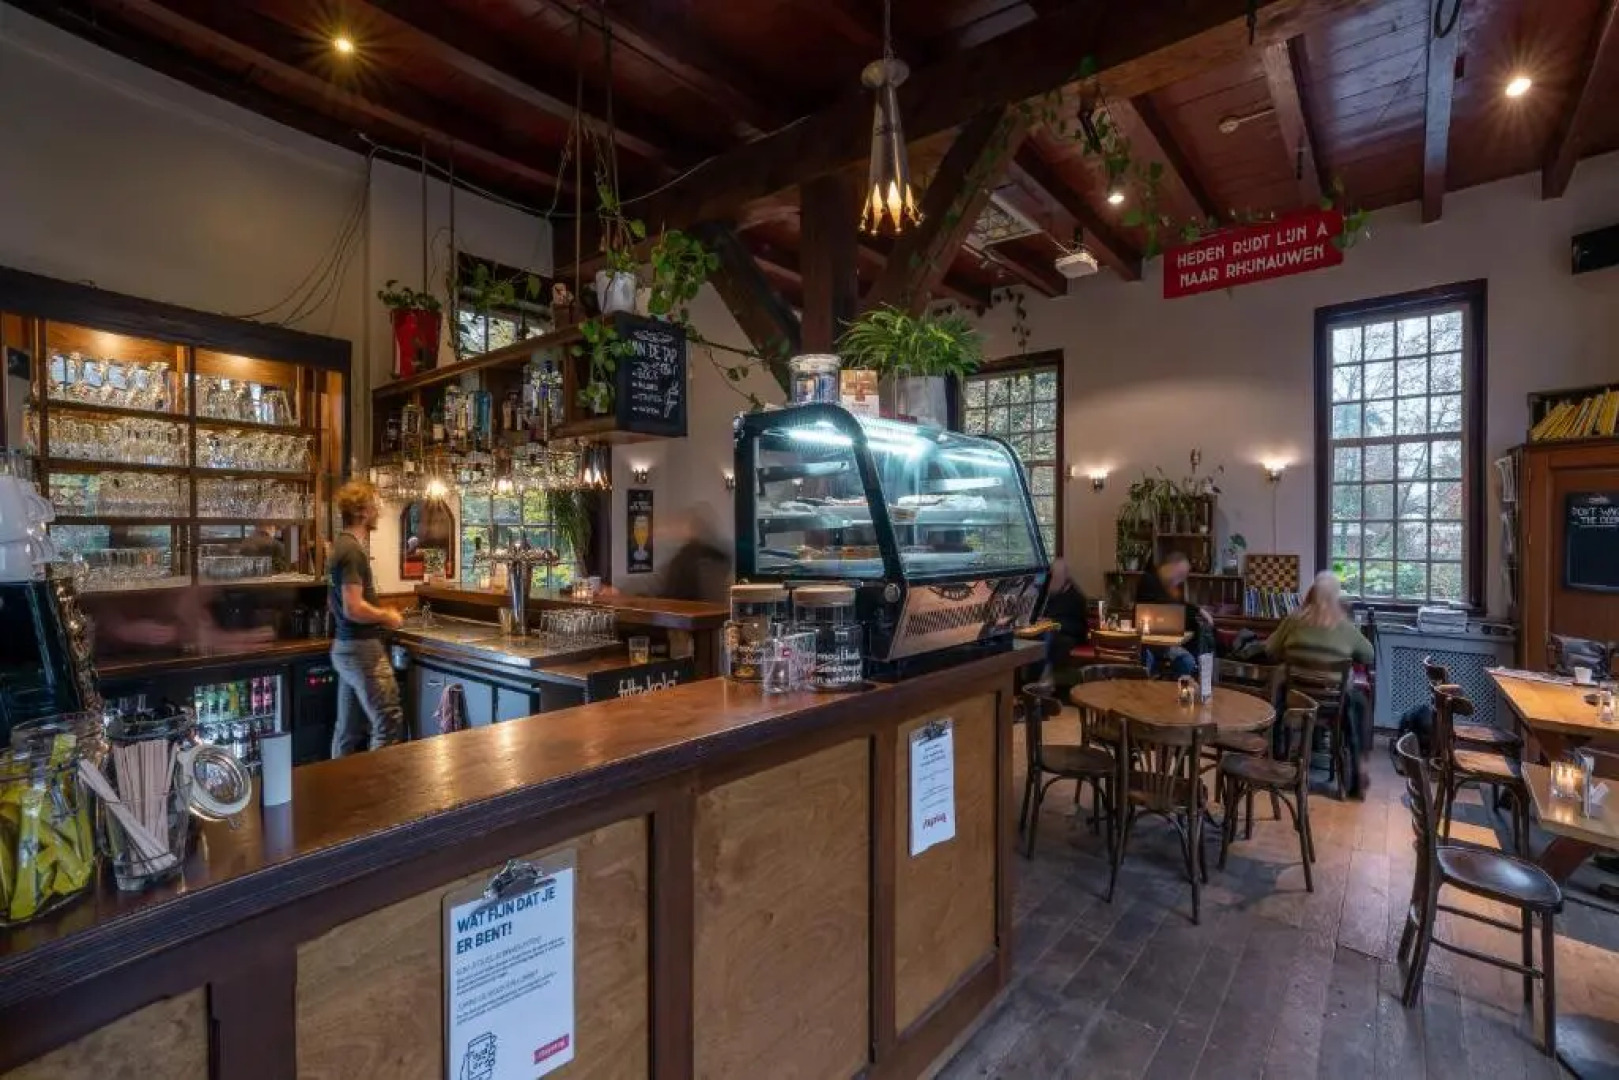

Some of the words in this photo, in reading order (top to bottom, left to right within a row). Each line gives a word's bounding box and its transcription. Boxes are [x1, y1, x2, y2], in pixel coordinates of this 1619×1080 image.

[1177, 244, 1225, 269] HEDEN
[1276, 224, 1307, 246] LIJN
[1316, 221, 1329, 237] A
[1180, 267, 1219, 288] NAAR
[457, 910, 486, 934] WAT
[488, 900, 515, 923] FIJN
[516, 891, 541, 912] DAT
[541, 886, 557, 903] JE
[456, 937, 473, 956] ER
[475, 921, 513, 949] BENT!
